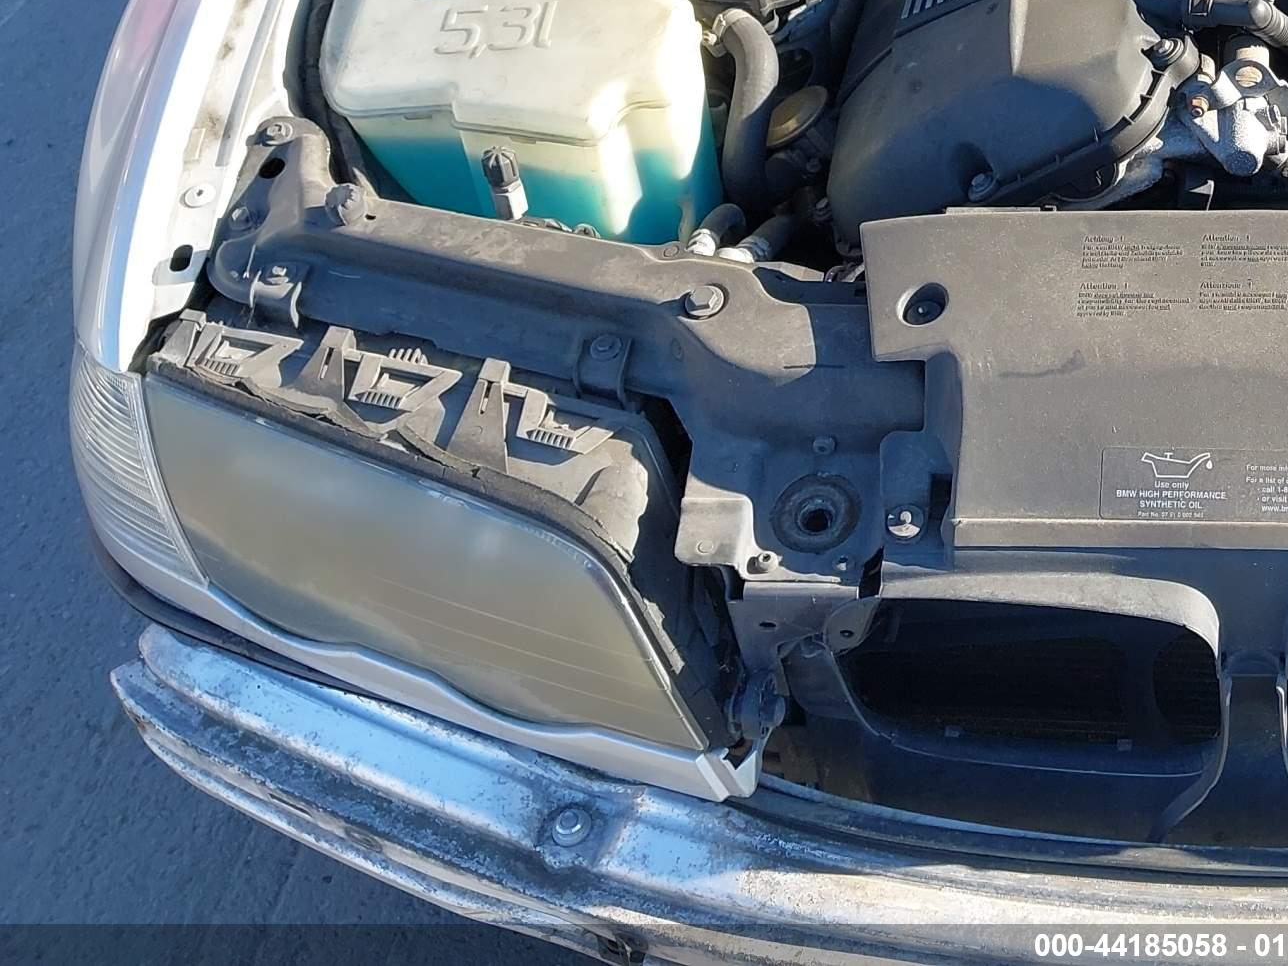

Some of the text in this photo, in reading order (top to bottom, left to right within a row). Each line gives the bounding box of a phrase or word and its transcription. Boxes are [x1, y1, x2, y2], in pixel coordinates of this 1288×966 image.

[1154, 480, 1190, 490] Use only
[1116, 489, 1227, 500] BMW HIGH PERFORMANCE
[1271, 495, 1287, 503] visit
[1139, 500, 1203, 509] SYNTHETIC OIL
